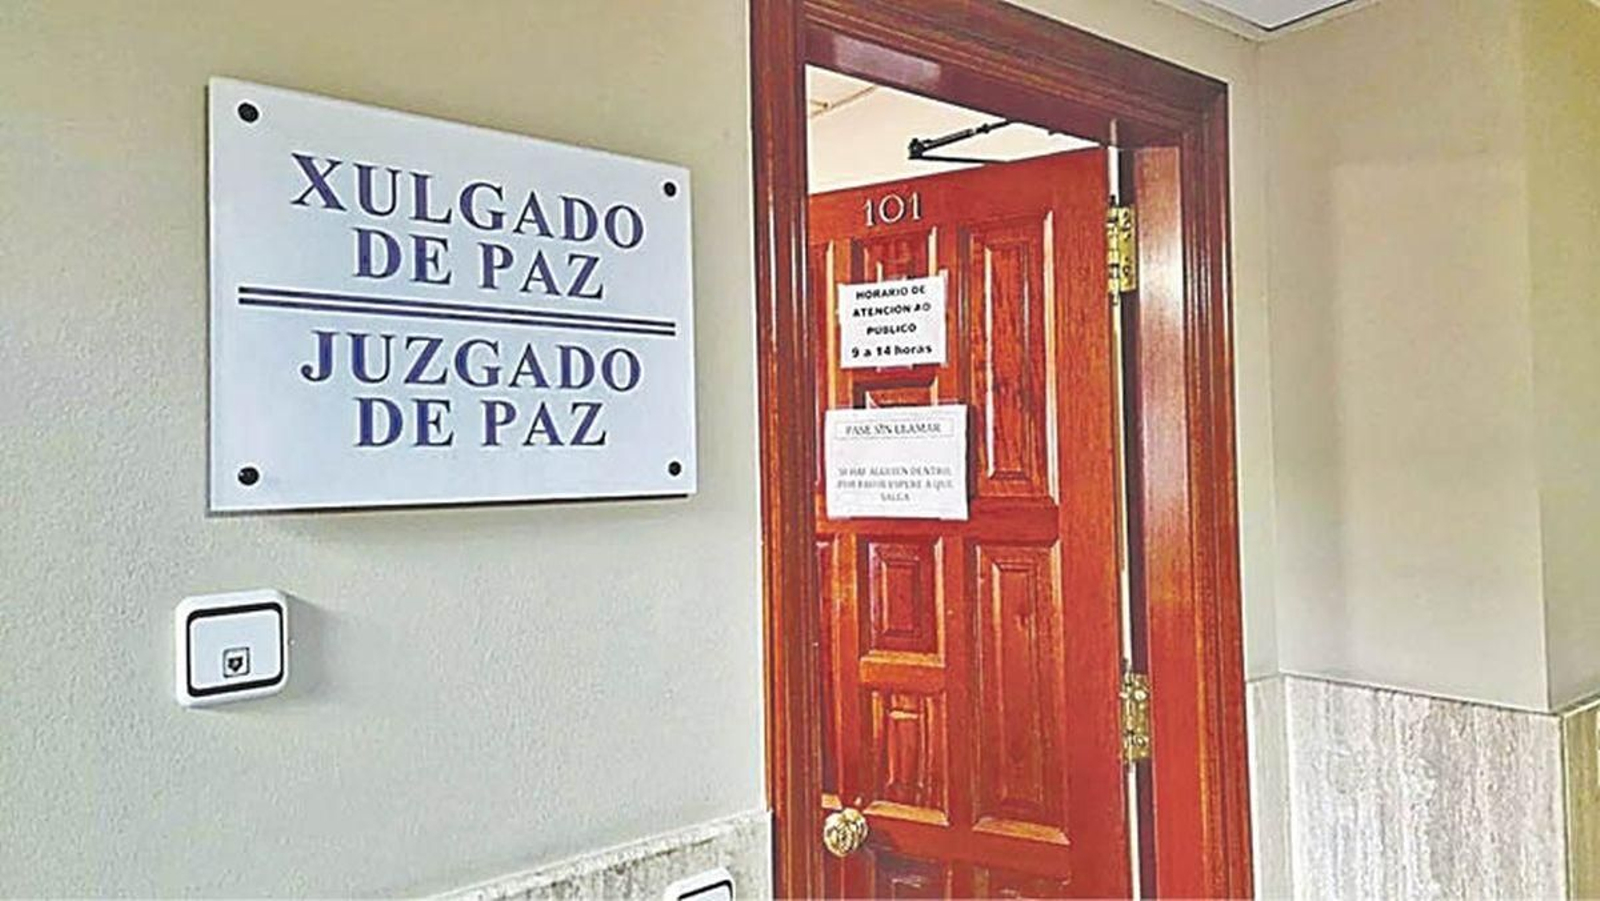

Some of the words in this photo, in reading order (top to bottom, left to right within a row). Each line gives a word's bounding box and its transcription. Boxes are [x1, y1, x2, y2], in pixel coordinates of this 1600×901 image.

[291, 152, 645, 249] XULGADO
[862, 192, 921, 227] 101
[353, 227, 453, 285] DE
[477, 241, 604, 300] PAZ
[856, 287, 908, 300] HORARIO
[911, 285, 925, 294] DE
[914, 302, 931, 312] AO
[300, 330, 642, 392] JUZGADO
[851, 346, 859, 358] 9
[863, 348, 872, 357] a
[876, 346, 891, 355] 14
[894, 345, 932, 355] horas
[354, 397, 454, 447] DE
[480, 401, 607, 447] PAZ
